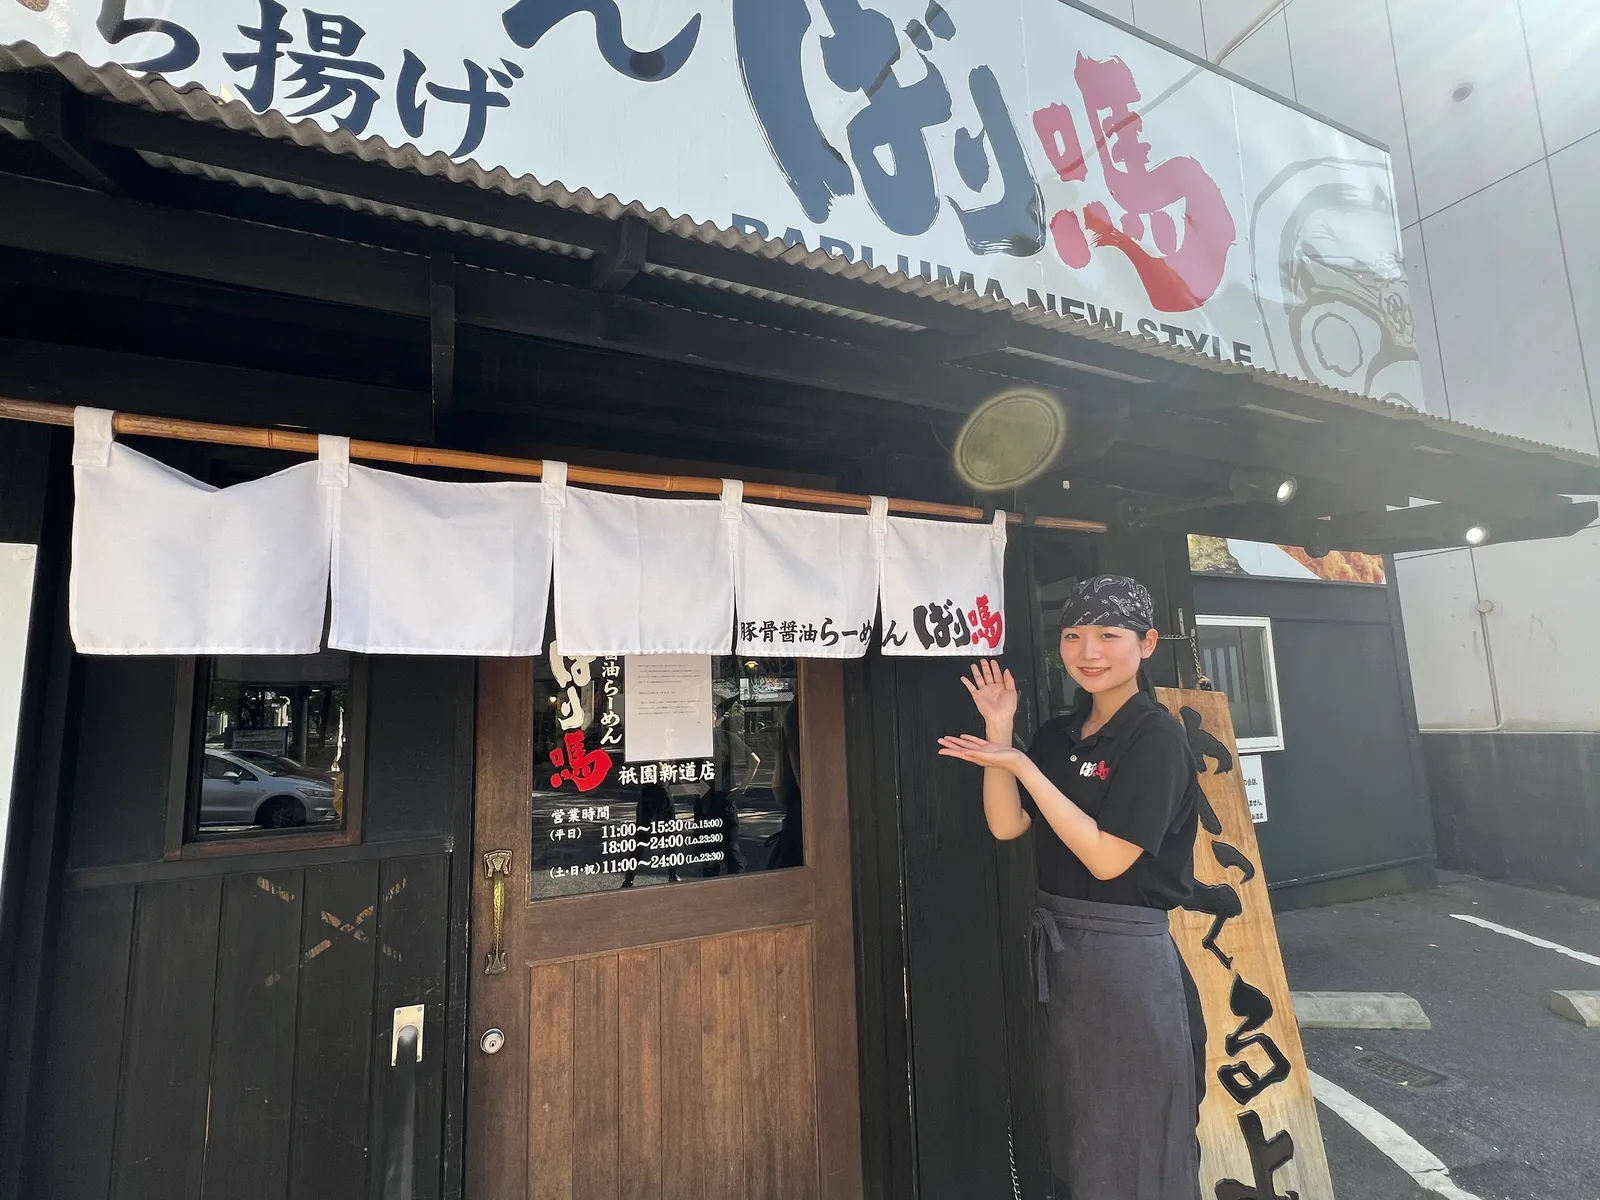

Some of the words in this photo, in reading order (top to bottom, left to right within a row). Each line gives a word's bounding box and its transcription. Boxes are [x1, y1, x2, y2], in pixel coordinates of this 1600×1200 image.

[600, 655, 622, 745] 油らーめん
[551, 805, 610, 825] 営業時間
[549, 828, 582, 842] (平日)
